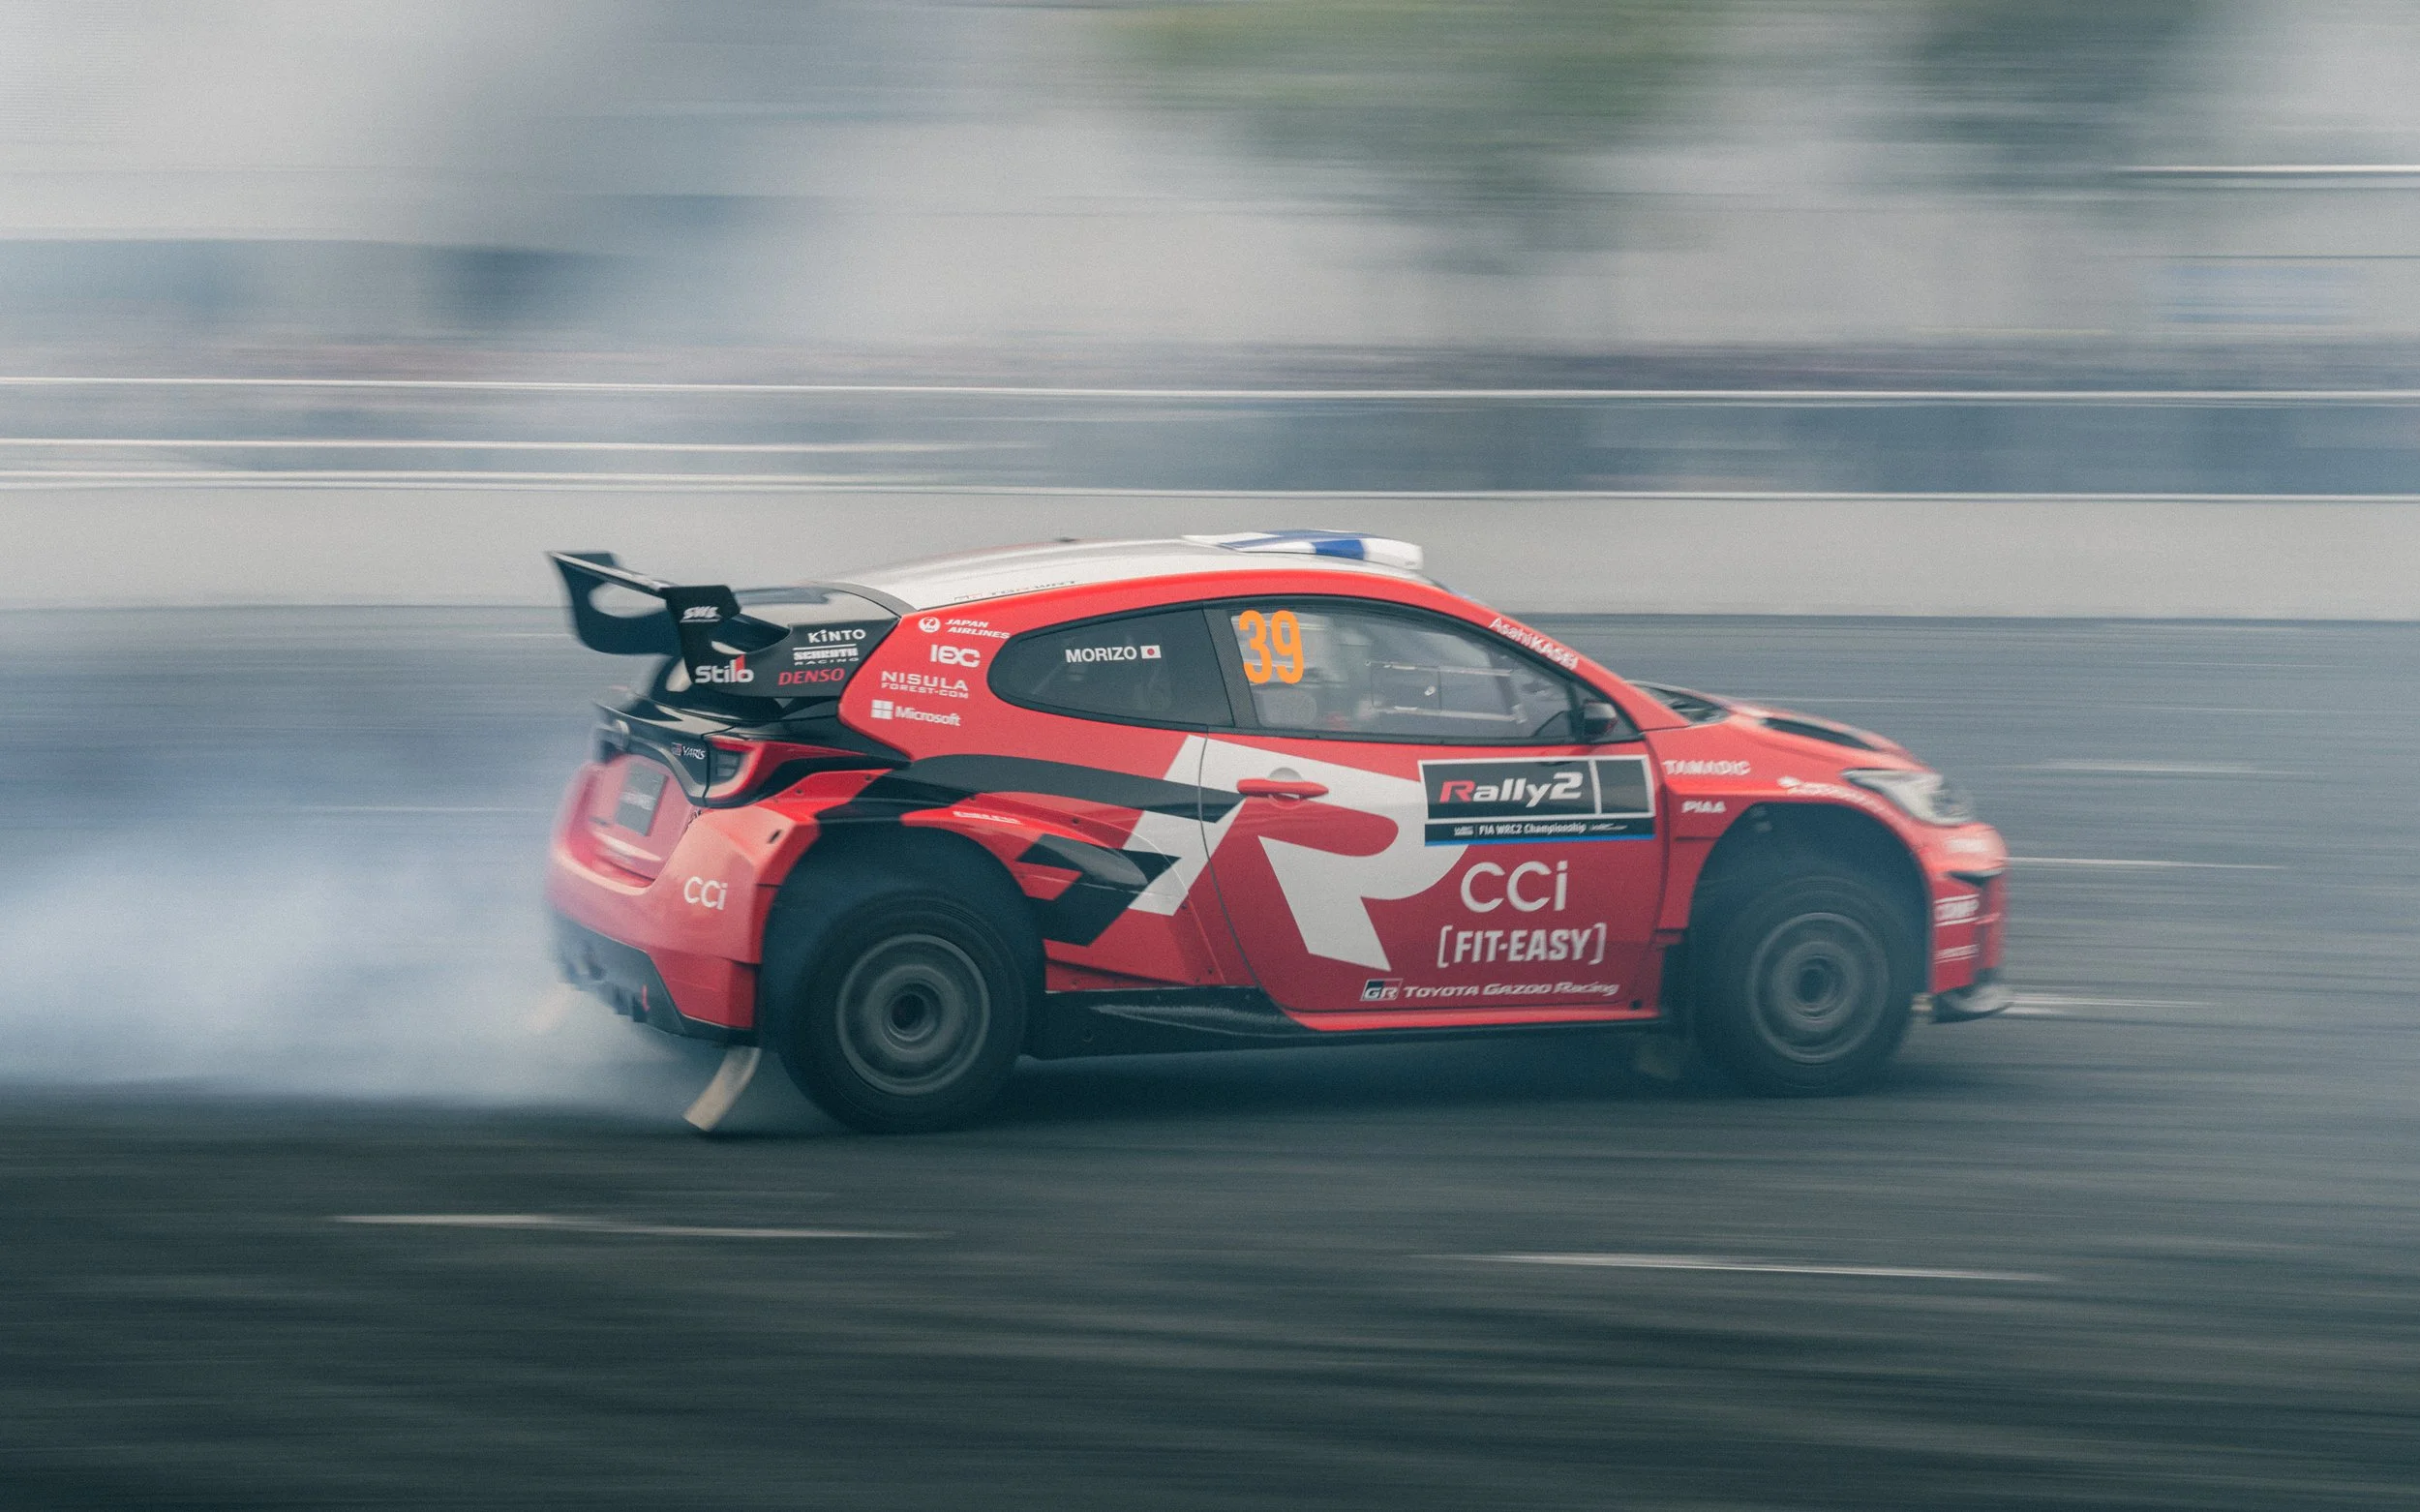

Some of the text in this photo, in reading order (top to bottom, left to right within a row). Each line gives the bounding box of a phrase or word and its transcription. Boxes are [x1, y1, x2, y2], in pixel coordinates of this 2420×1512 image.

[945, 619, 988, 628] JAPAN
[948, 626, 1011, 639] AIRLINES
[1066, 647, 1136, 663] MORIZO
[1238, 610, 1304, 684] 39
[695, 656, 754, 683] Stilo
[777, 668, 846, 686] DENSO
[881, 670, 968, 691] NISULA
[895, 706, 961, 726] Microsoft
[1438, 771, 1584, 808] Rally2
[1681, 800, 1727, 814] PIAA
[1363, 981, 1620, 1000] GR TOYOTA GAZOO Racing
